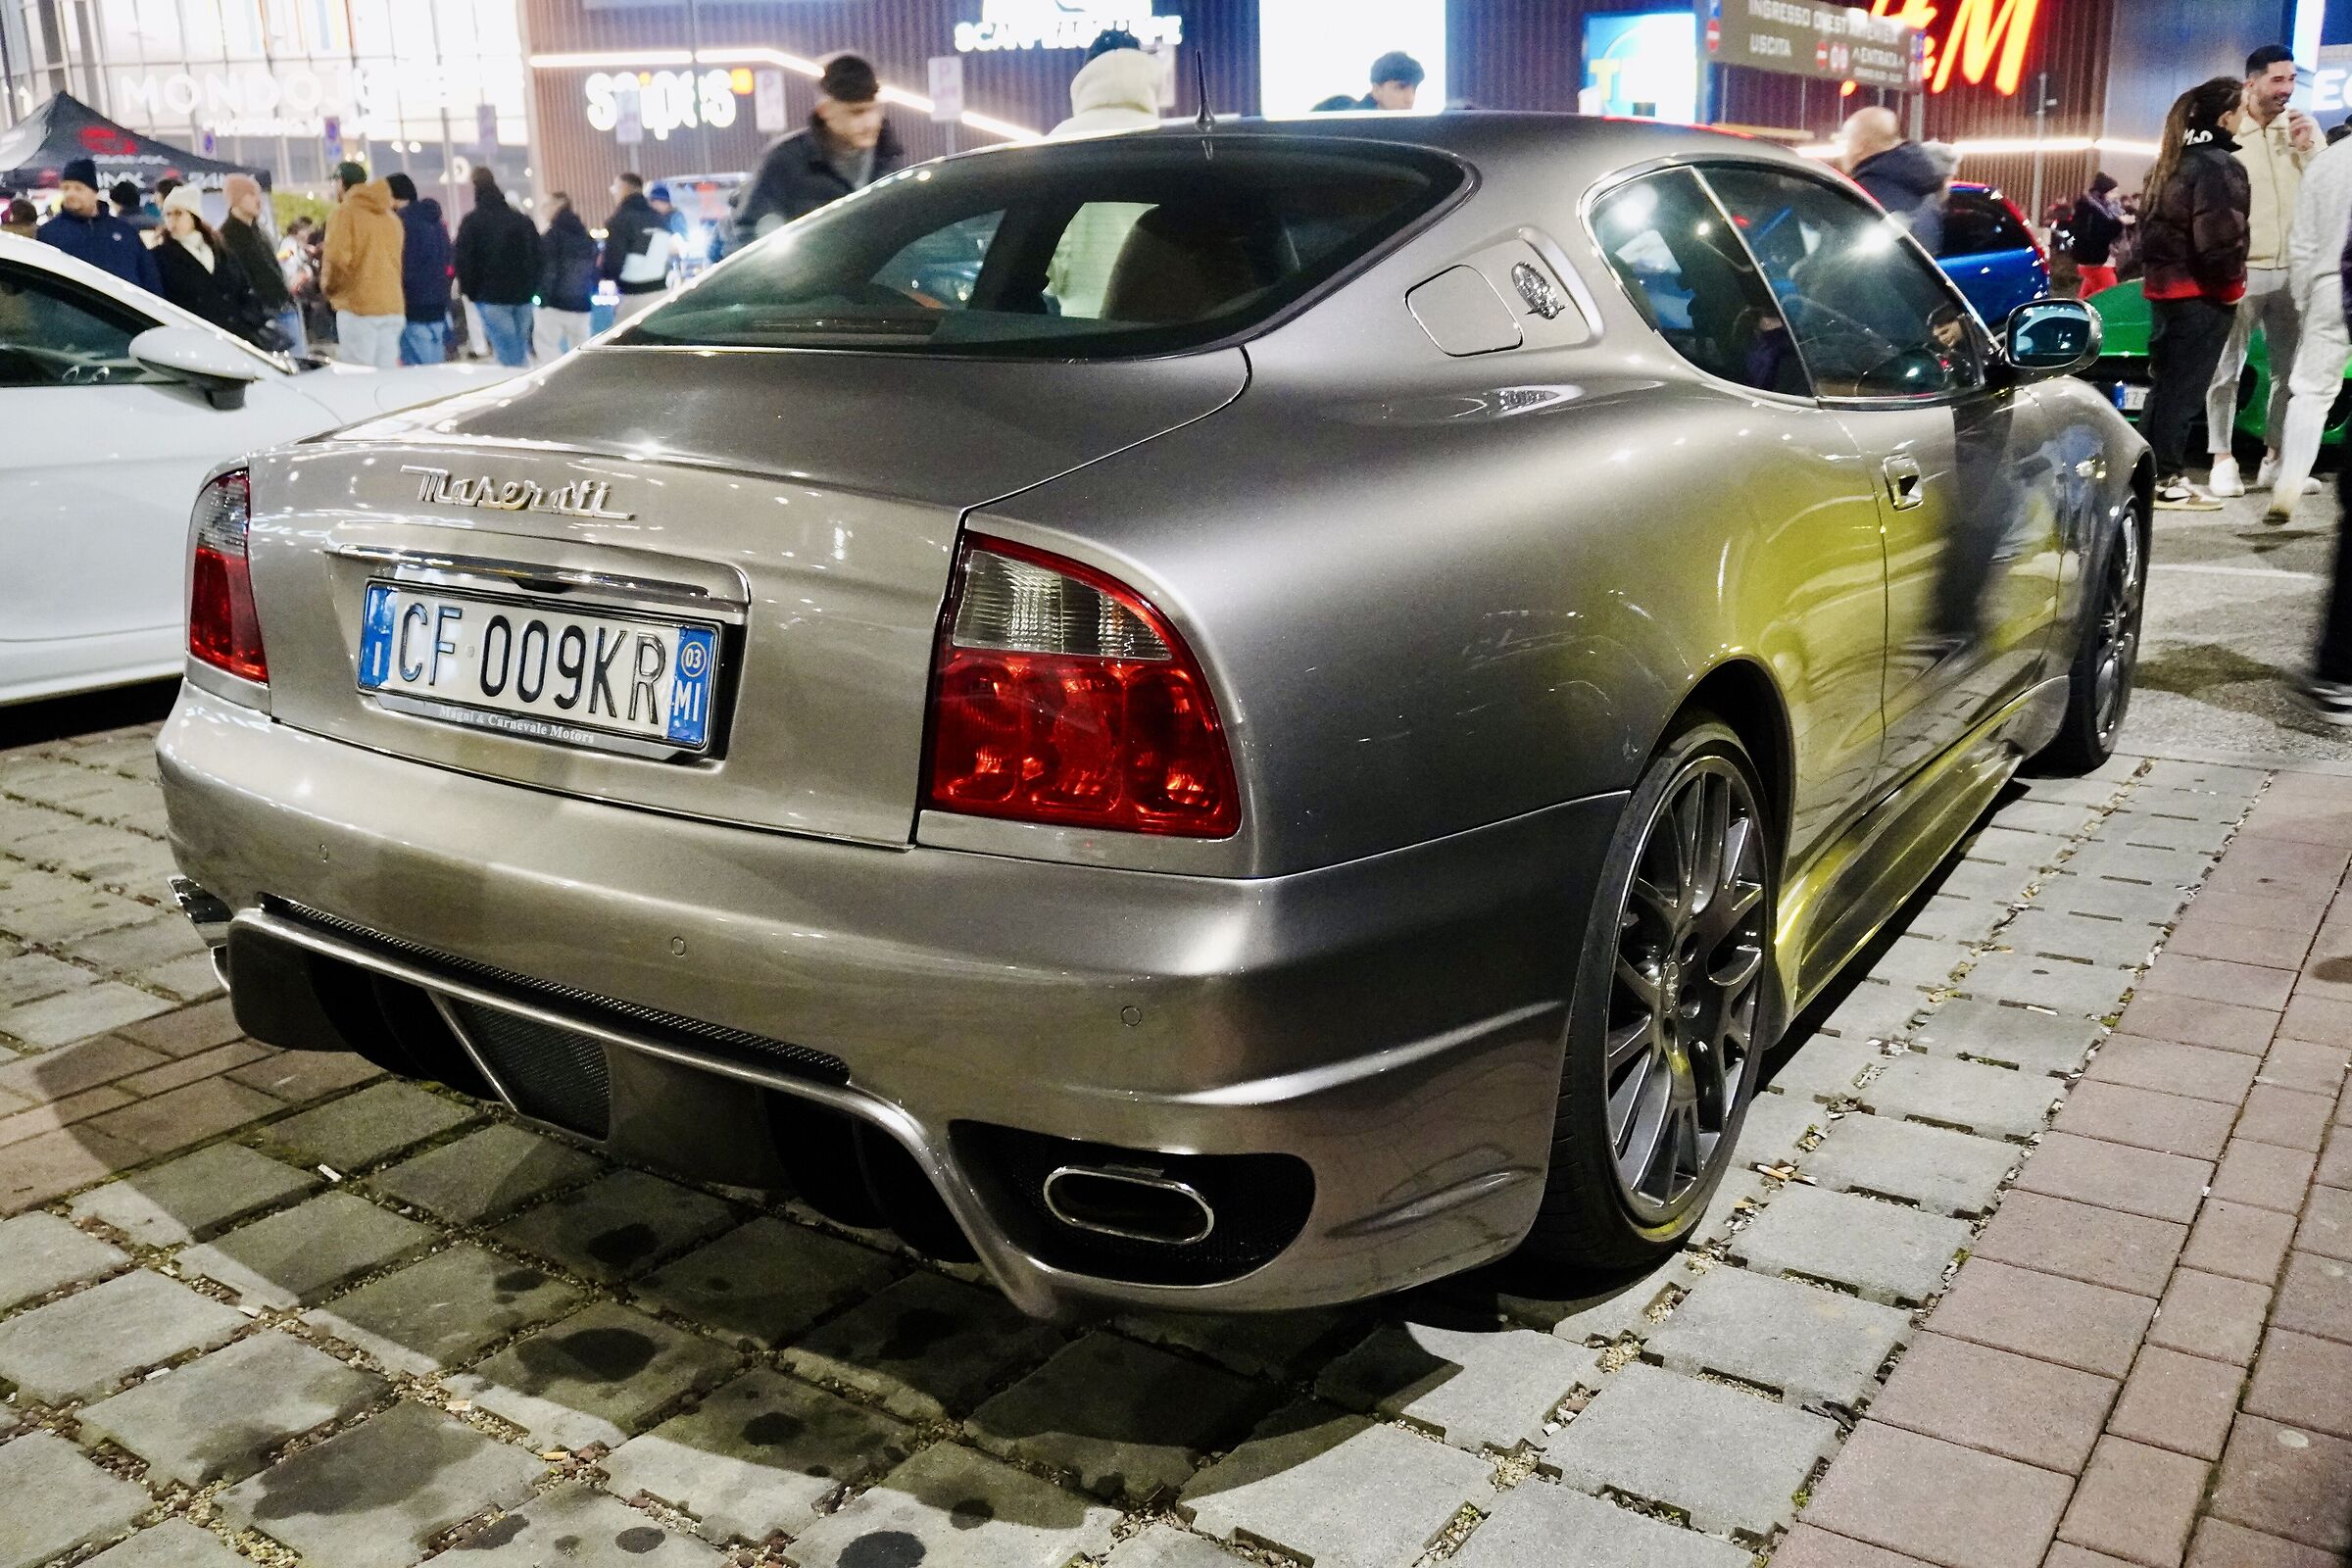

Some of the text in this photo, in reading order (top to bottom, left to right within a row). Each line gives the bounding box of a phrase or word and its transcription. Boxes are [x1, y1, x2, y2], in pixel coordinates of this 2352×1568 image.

[400, 465, 635, 520] Maserati
[399, 603, 463, 685] CF
[686, 648, 701, 669] 03
[673, 679, 702, 722] MI
[439, 706, 595, 744] Magni & Carnevale Motors
